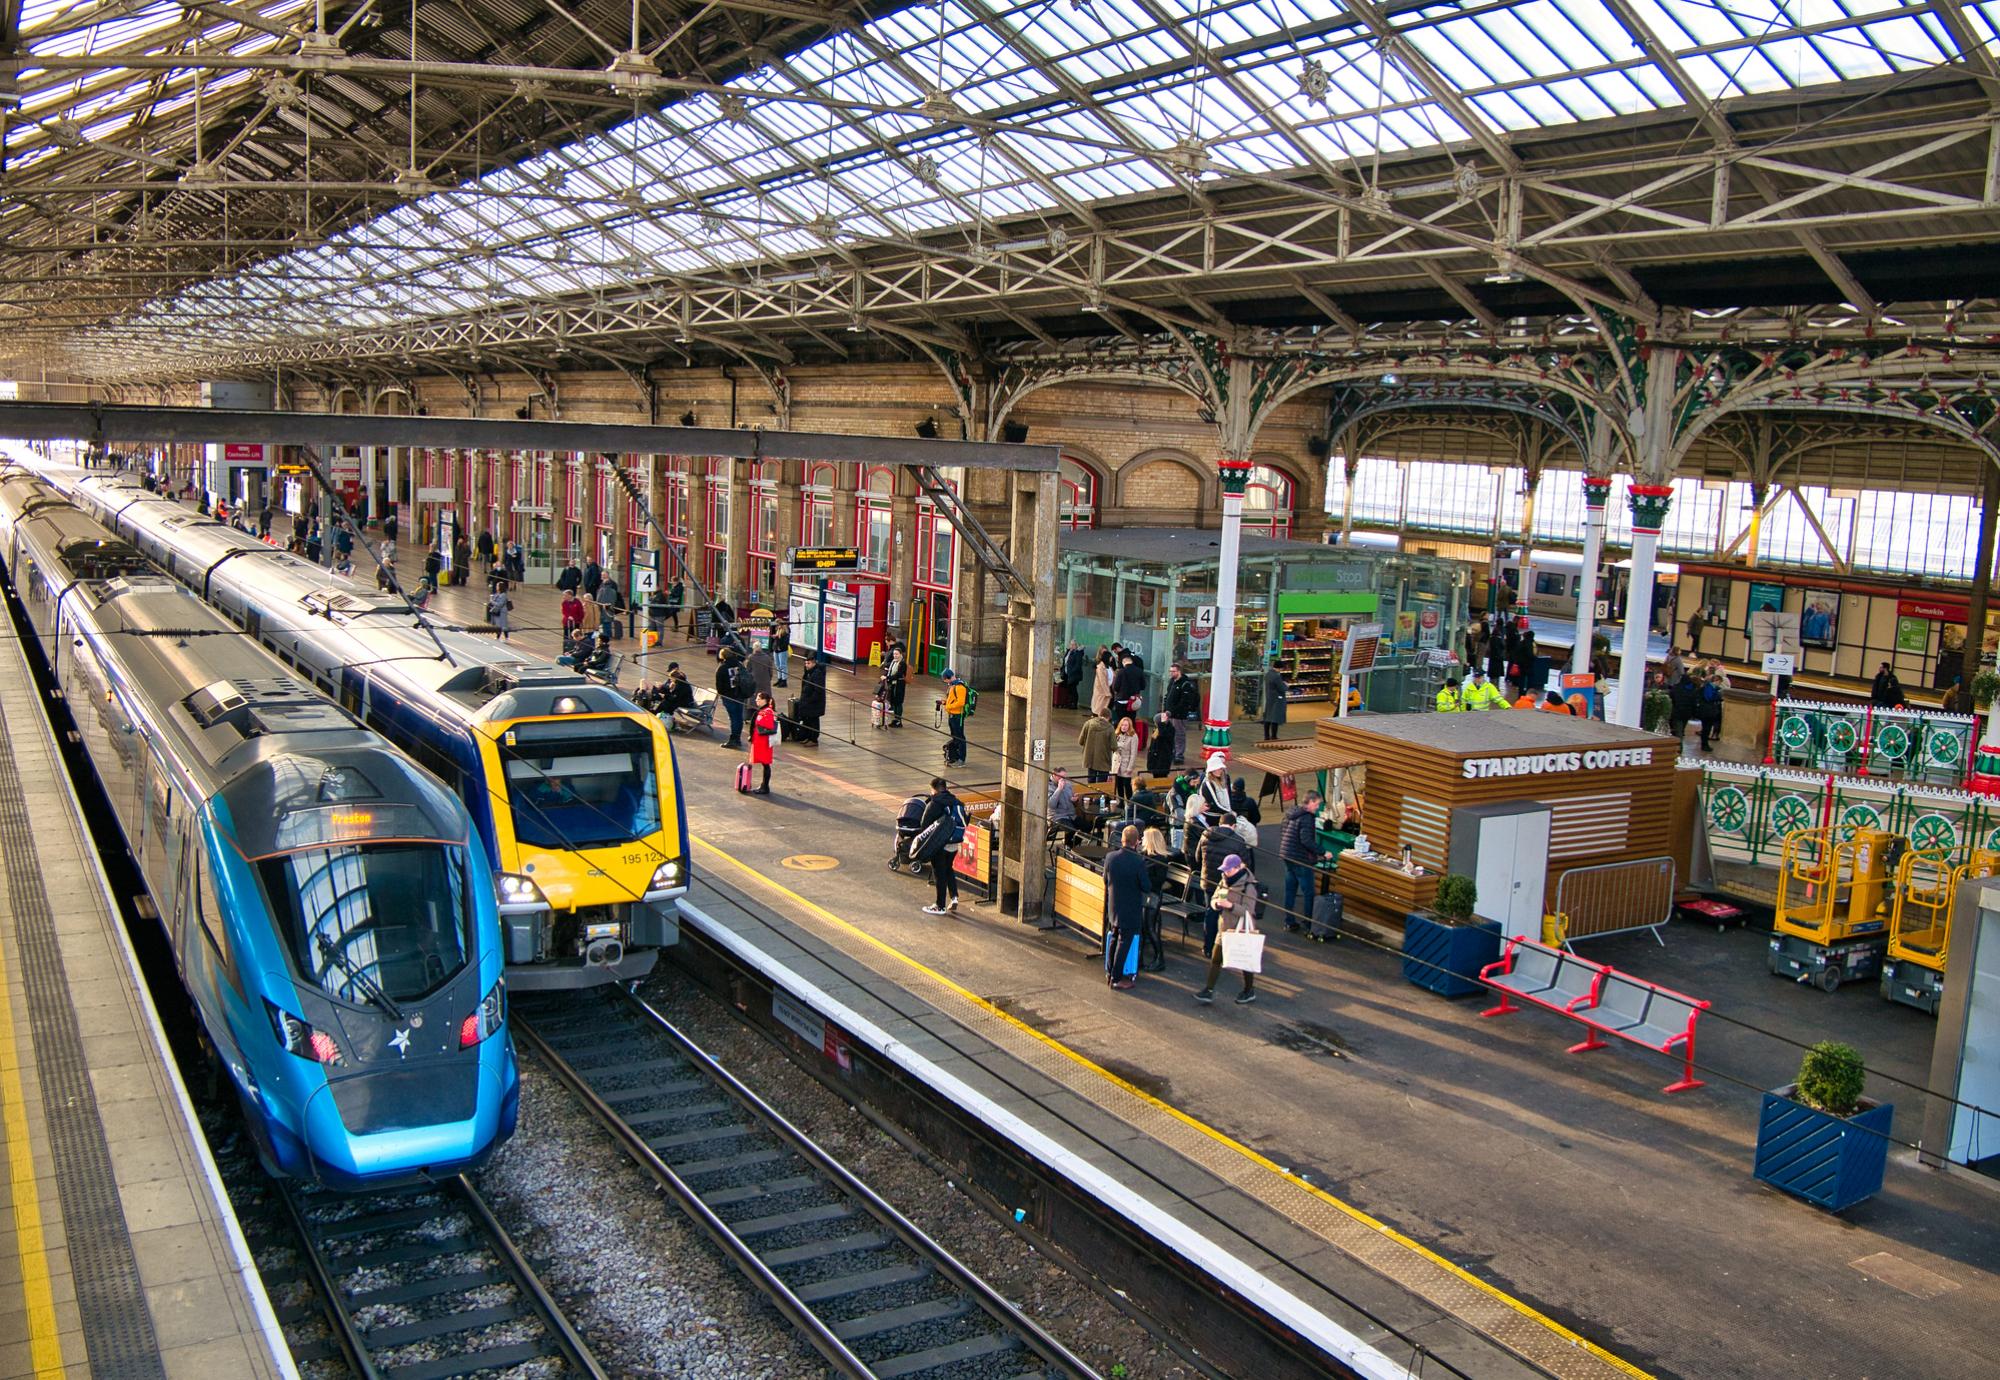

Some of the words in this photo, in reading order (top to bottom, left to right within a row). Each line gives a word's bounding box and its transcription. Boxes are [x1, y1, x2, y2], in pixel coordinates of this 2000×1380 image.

[642, 573, 653, 589] 4
[1200, 608, 1211, 624] 4
[1599, 603, 1606, 616] 3
[1914, 606, 1945, 617] Pumpkin
[1463, 752, 1581, 779] STARBUCKS
[1583, 748, 1653, 770] COFFEE
[332, 812, 372, 825] Preston
[622, 854, 641, 865] 195
[644, 852, 663, 863] 123
